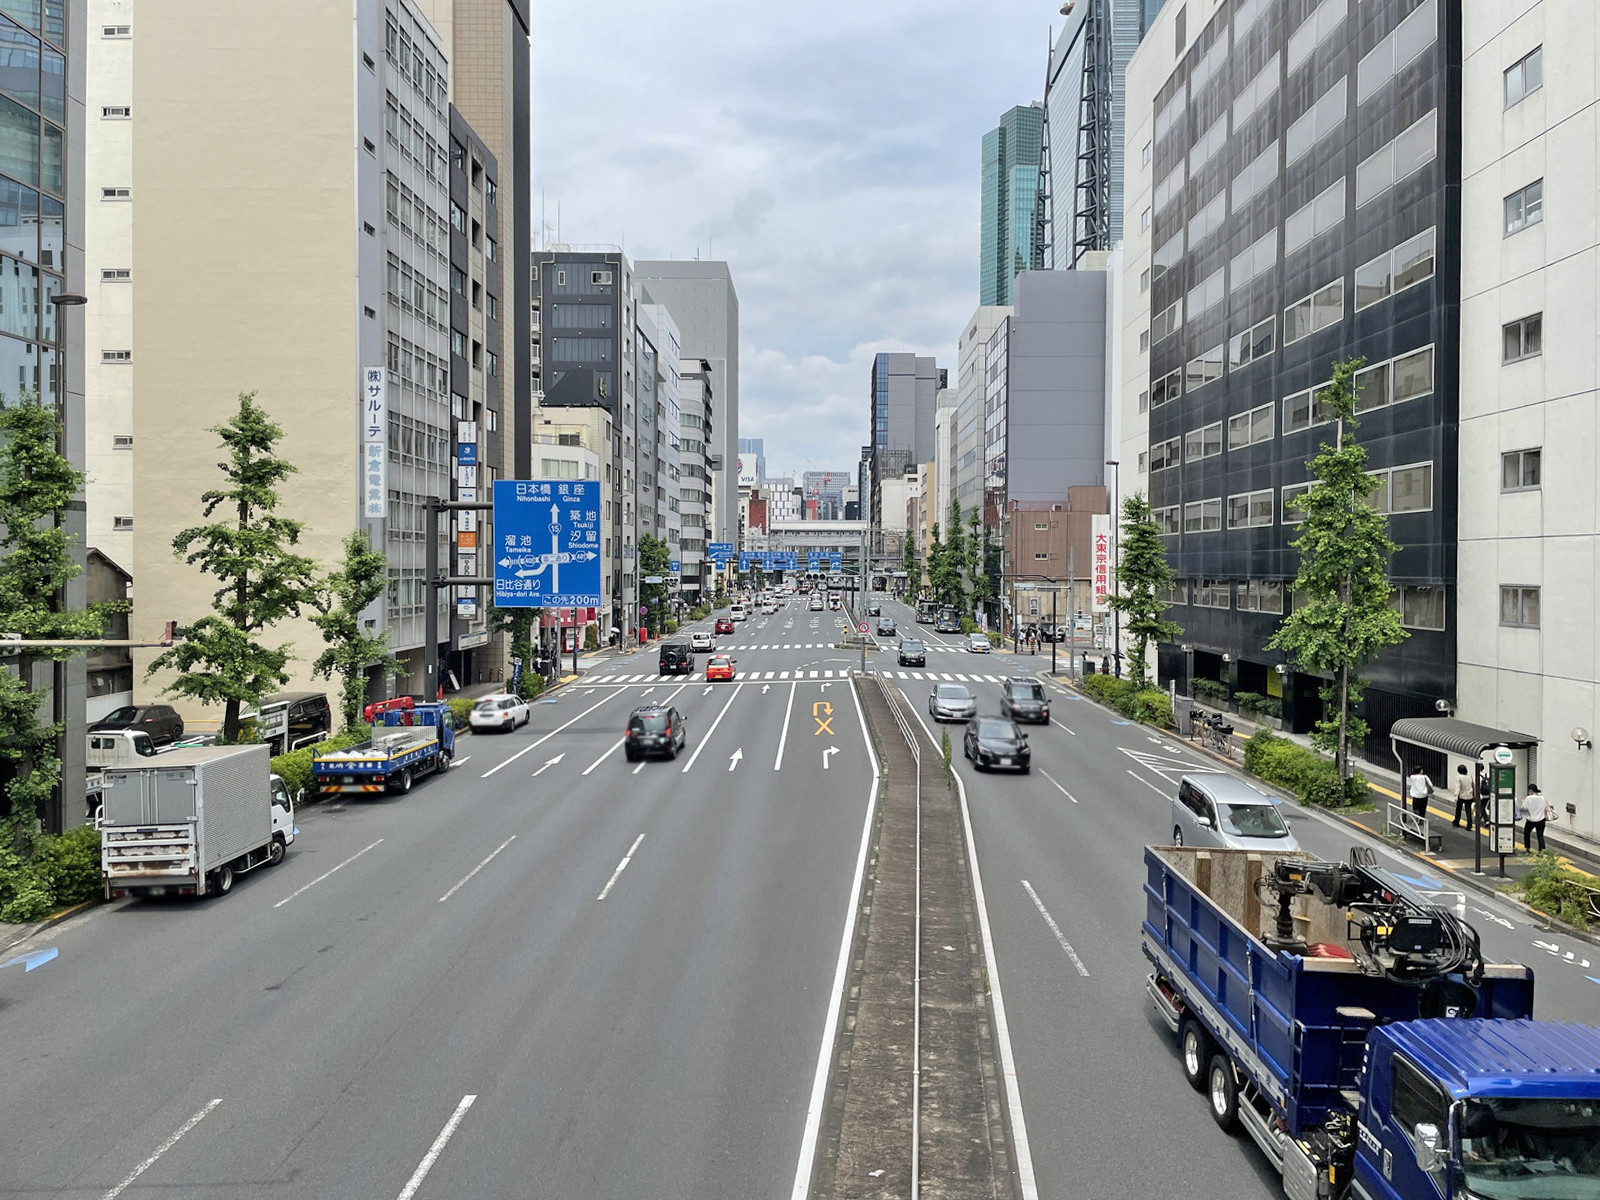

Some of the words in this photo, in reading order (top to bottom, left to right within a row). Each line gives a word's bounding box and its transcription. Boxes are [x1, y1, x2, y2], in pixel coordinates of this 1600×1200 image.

[516, 483, 551, 495] 日本橋
[558, 483, 585, 495] 銀座
[569, 510, 597, 521] 築地
[551, 525, 560, 533] 15
[505, 535, 532, 546] 溜池
[570, 530, 597, 542] 汐留
[1096, 534, 1107, 605] 大東京信用組合
[496, 579, 541, 590] 日比谷通り
[543, 595, 599, 605] この先200m
